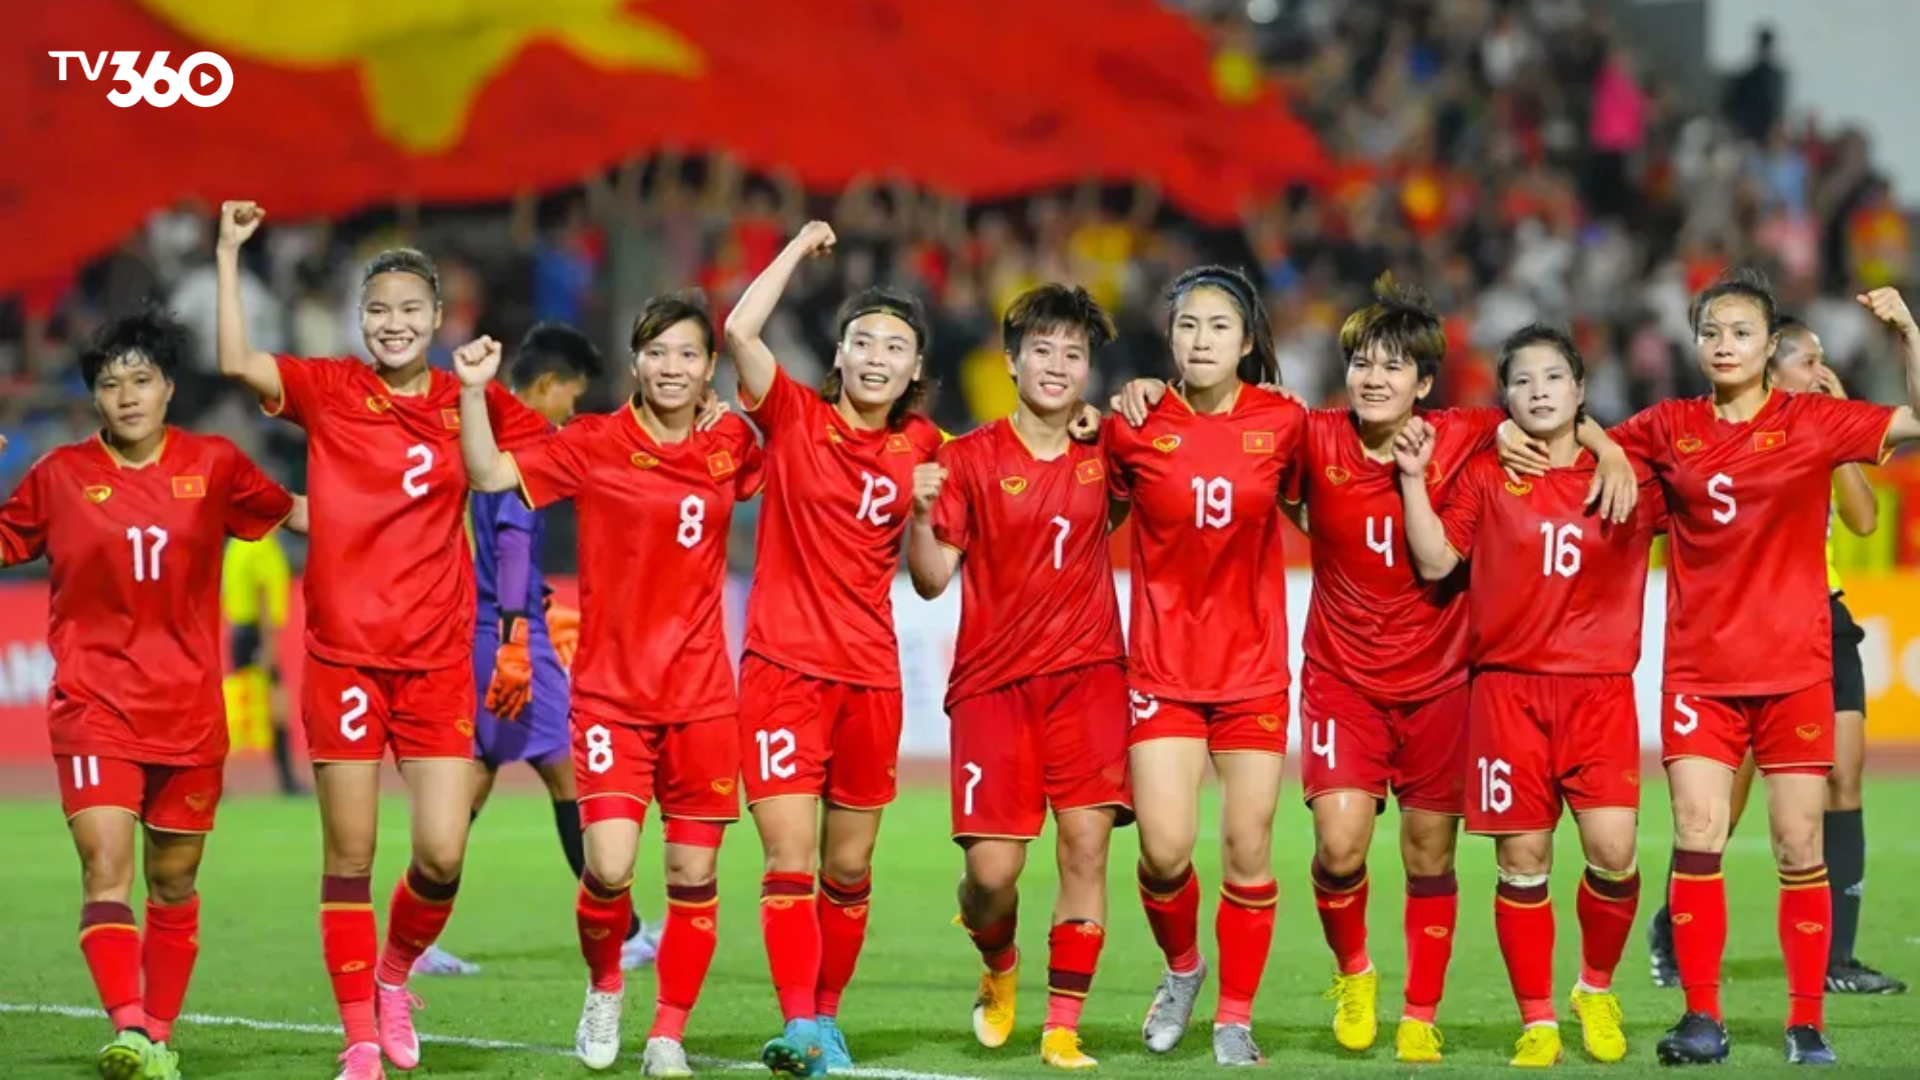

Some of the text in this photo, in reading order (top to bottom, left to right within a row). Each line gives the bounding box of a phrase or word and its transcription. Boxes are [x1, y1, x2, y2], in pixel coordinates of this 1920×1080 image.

[403, 444, 433, 498] 2
[856, 470, 898, 526] 12
[677, 494, 705, 548] 8
[1191, 476, 1233, 529] 19
[126, 525, 168, 581] 17
[1051, 515, 1071, 569] 7
[1367, 516, 1393, 567] 4
[1540, 520, 1583, 577] 16
[340, 686, 368, 742] 2
[586, 724, 614, 774] 8
[755, 727, 796, 781] 12
[1311, 717, 1336, 770] 4
[963, 762, 982, 816] 7
[1477, 756, 1512, 814] 16
